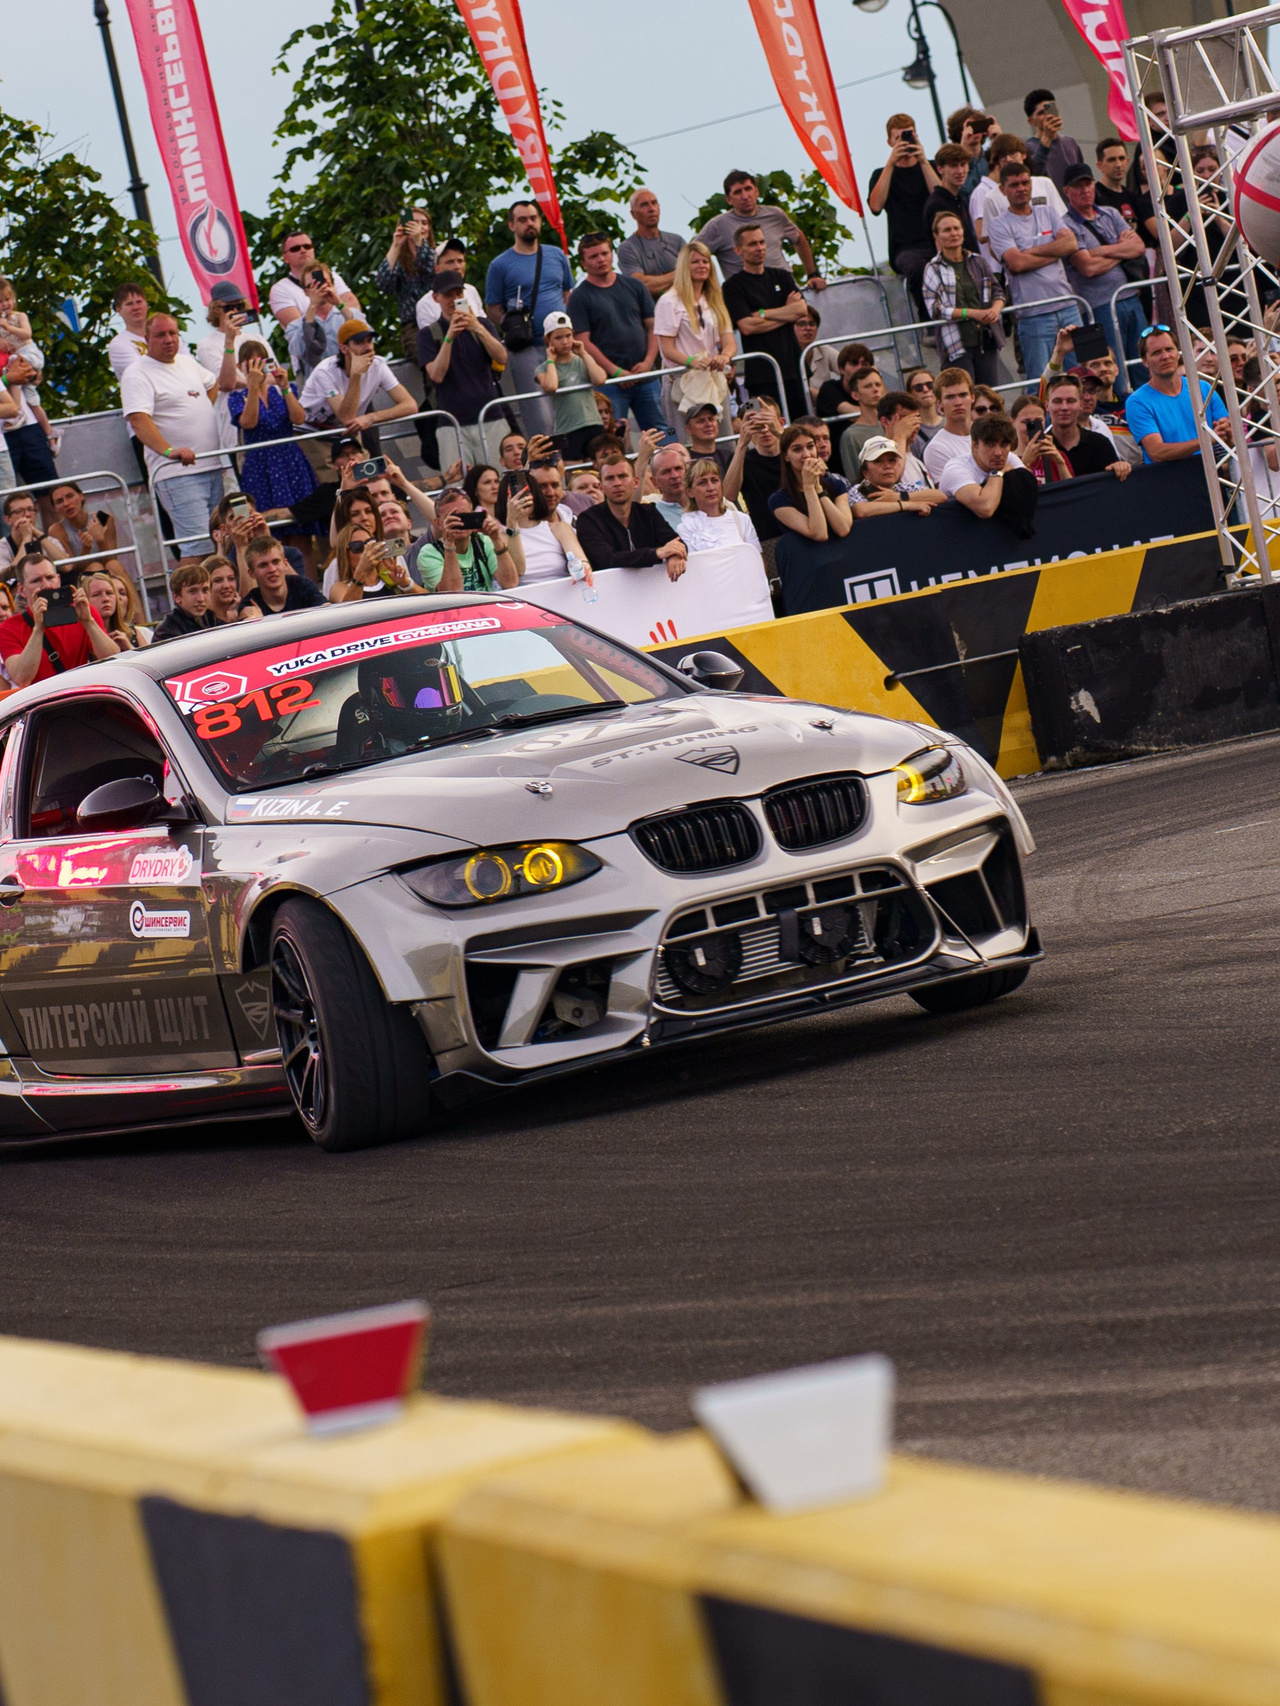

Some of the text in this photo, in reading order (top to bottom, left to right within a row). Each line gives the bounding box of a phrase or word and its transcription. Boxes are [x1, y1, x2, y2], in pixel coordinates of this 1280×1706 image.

[272, 620, 492, 676] YUKA DRIVE GYMKHANA
[192, 678, 321, 740] 812
[592, 715, 759, 769] ST-TUNING
[251, 799, 306, 817] KIZIN
[131, 858, 178, 879] DRYDRY
[145, 916, 187, 928] ШИНСЕРВИС
[18, 988, 210, 1050] ПИТЕРСКИЙ ЩИТ
